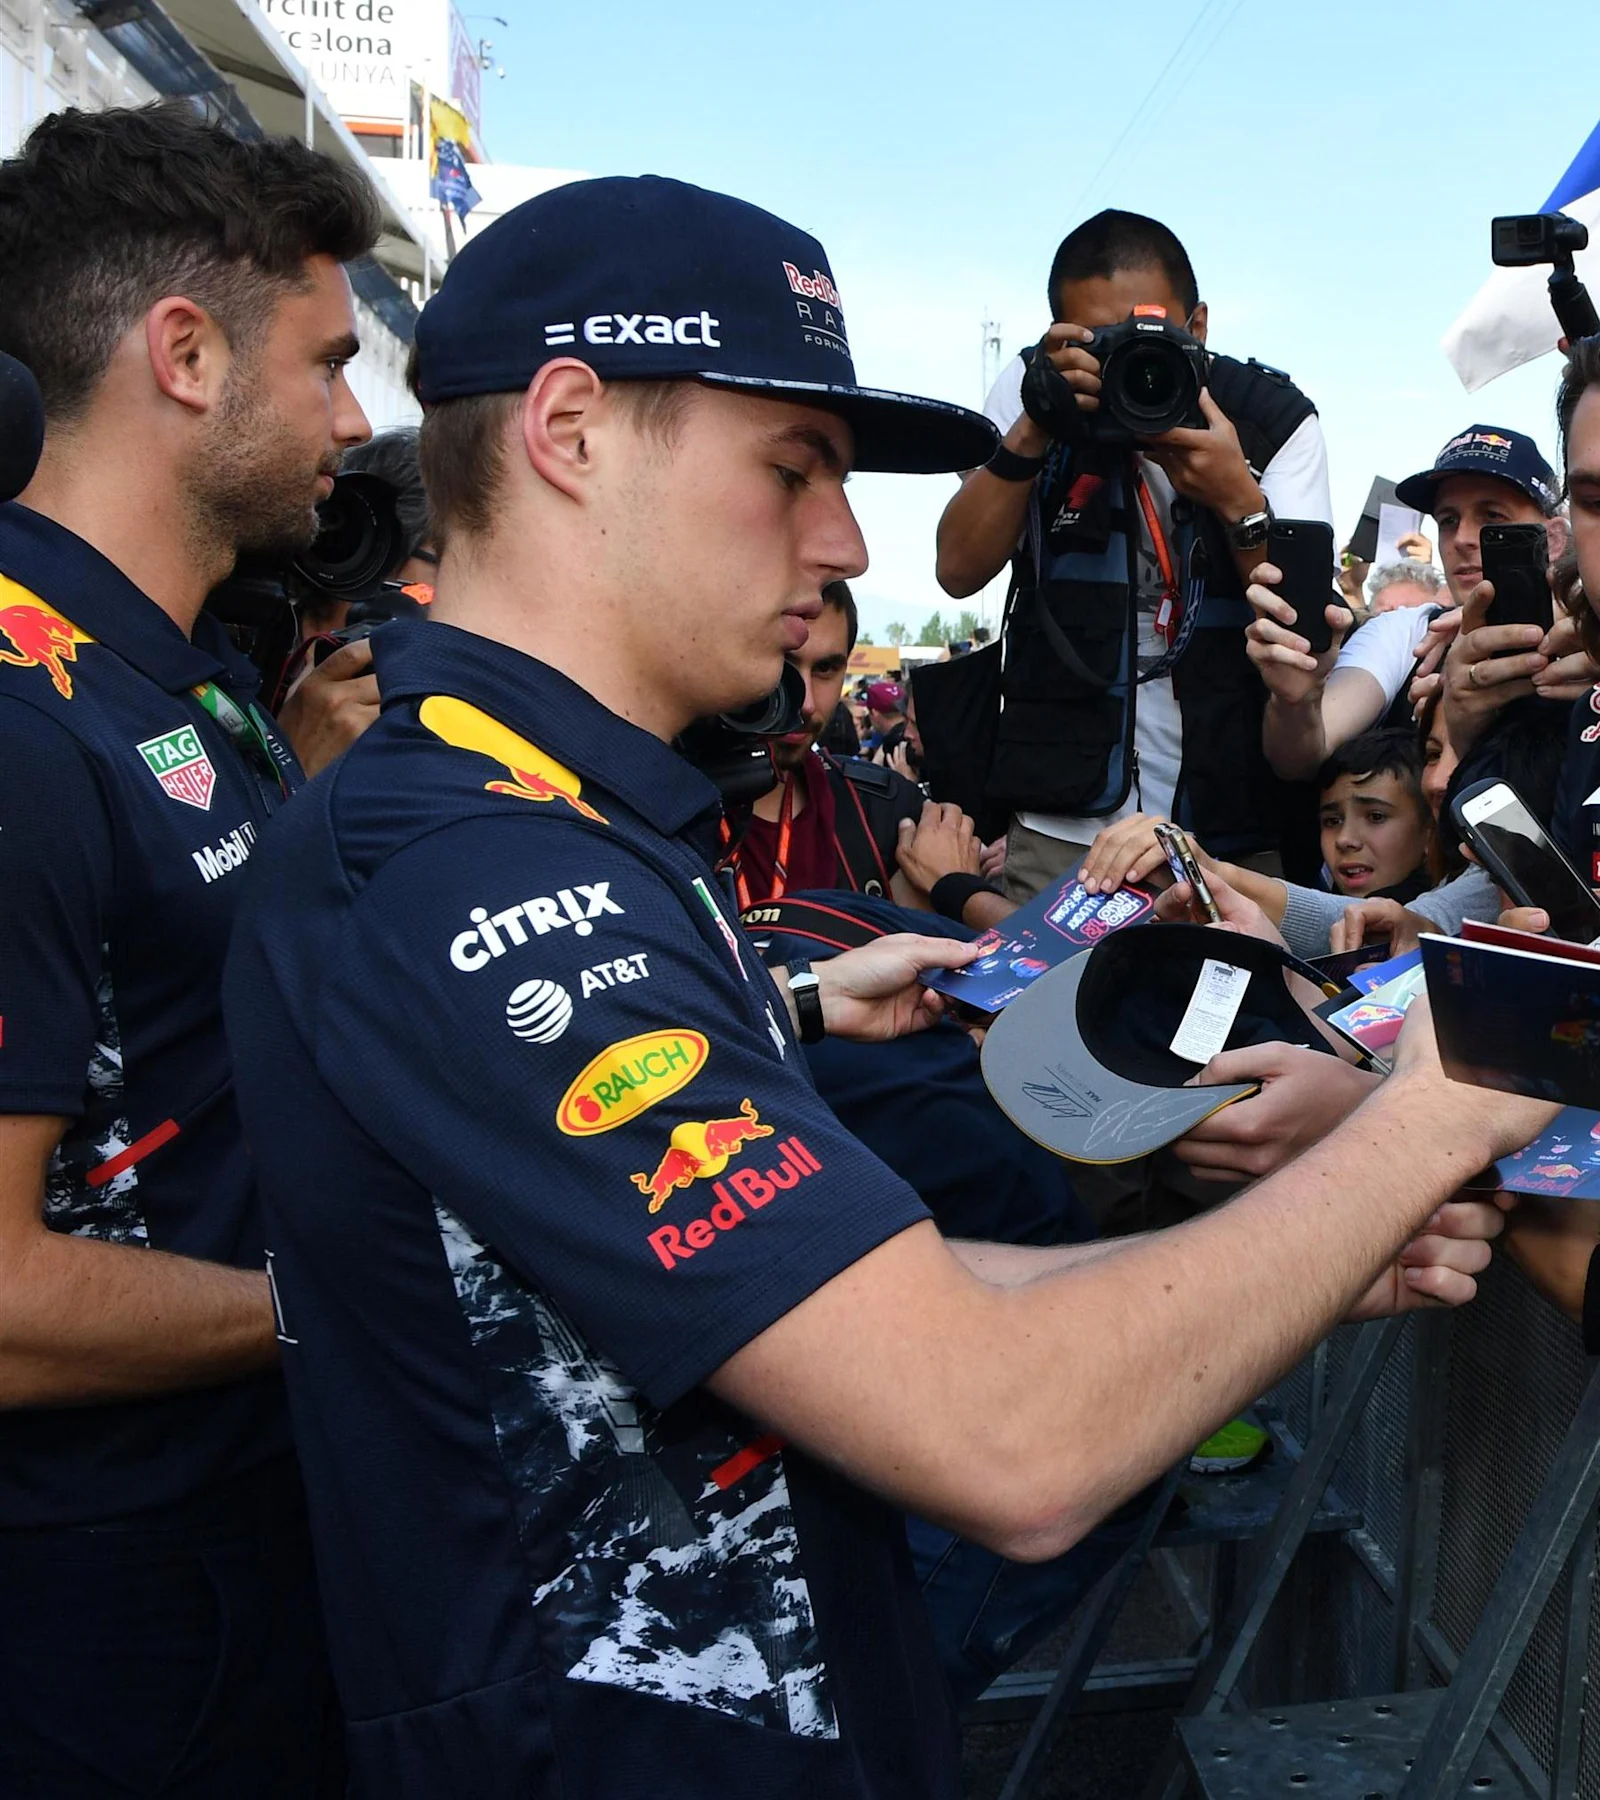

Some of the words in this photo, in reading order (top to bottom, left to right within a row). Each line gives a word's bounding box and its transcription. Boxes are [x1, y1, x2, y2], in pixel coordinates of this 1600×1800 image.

[355, 0, 394, 23] de
[584, 311, 720, 348] exact
[1136, 323, 1164, 332] Canon
[144, 733, 199, 769] TAG
[163, 763, 212, 806] HEUER
[192, 829, 250, 884] Mobil
[580, 953, 650, 999] AT&T
[593, 1040, 690, 1109] RAUCH
[647, 1180, 747, 1270] Red
[729, 1137, 823, 1211] Bull
